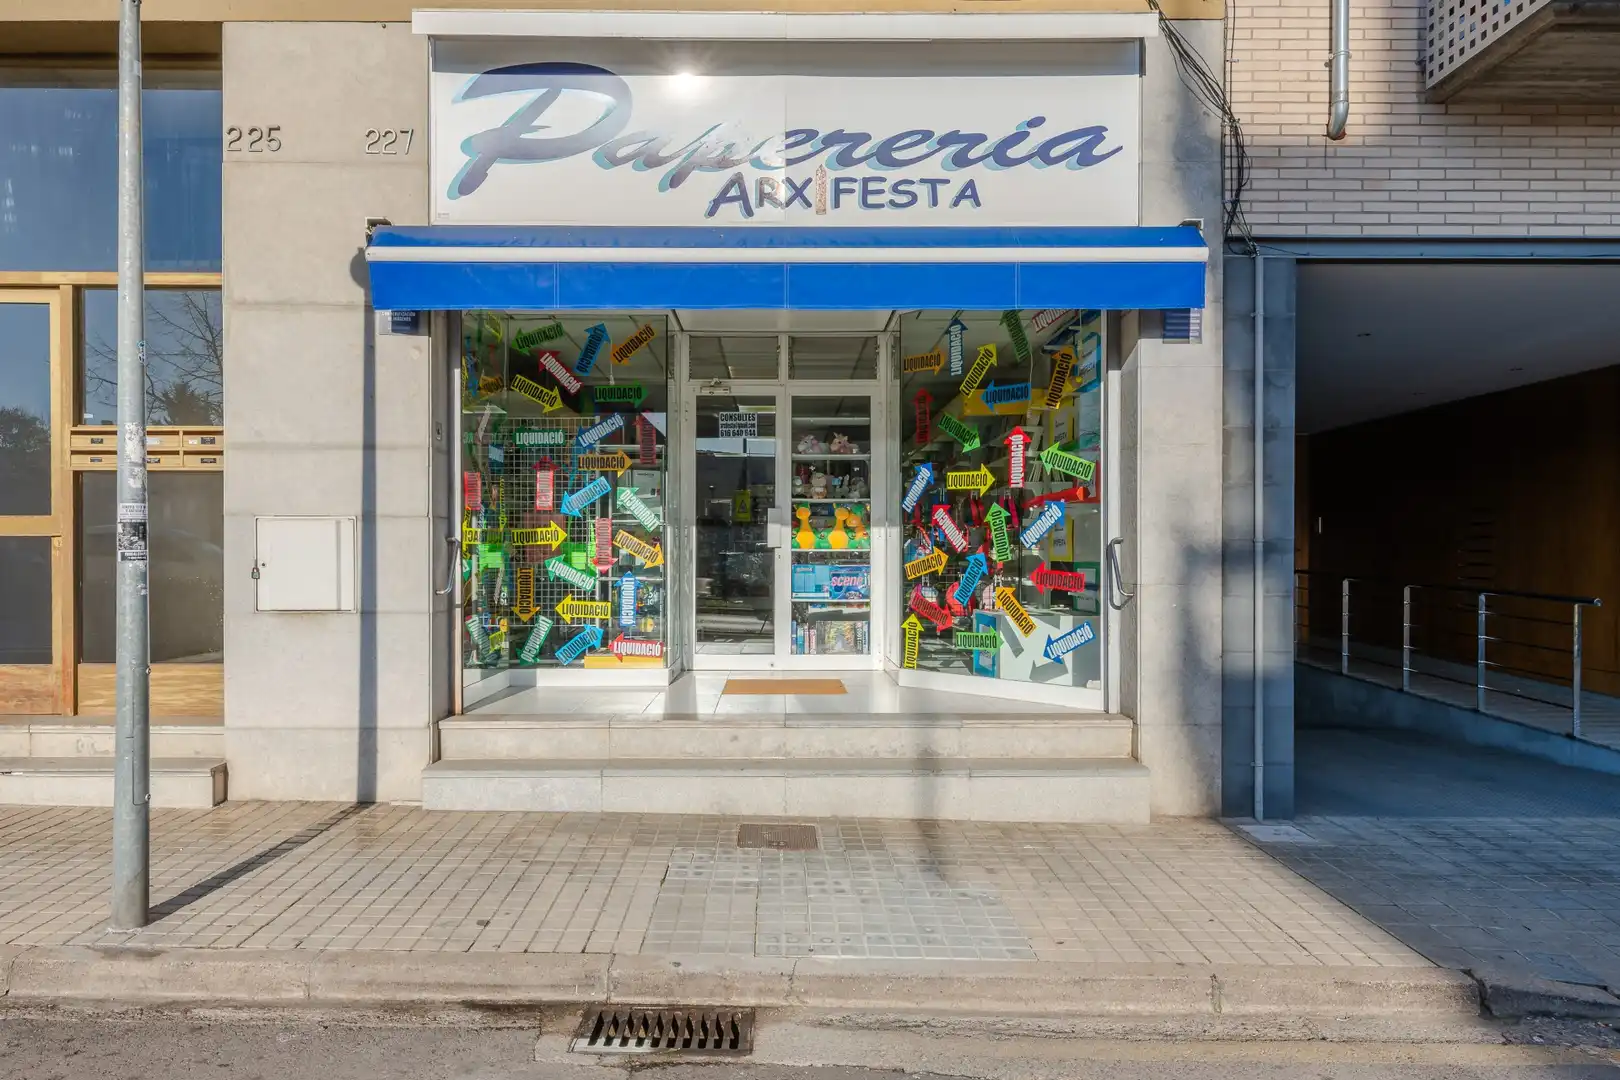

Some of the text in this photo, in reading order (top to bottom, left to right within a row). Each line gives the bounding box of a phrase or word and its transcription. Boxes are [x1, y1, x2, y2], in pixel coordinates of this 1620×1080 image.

[226, 125, 282, 153] 225
[365, 127, 414, 155] 227
[447, 62, 1122, 200] Papereria
[515, 322, 564, 349] LIQUIDACIÓ
[613, 324, 655, 363] LIQUIDACIÓ
[951, 324, 962, 376] LIQUIDACIÓ
[540, 352, 583, 394] LIQUIDACIÓ
[903, 353, 941, 372] LIQUIDACIÓ
[961, 347, 994, 396] LIQUIDACIÓ
[511, 376, 558, 408] LIQUIDACIÓ
[595, 386, 642, 400] LIQUIDACIÓ
[1046, 352, 1073, 409] LIQUIDACIÓ
[578, 413, 624, 447] LIQUIDACIÓ
[720, 413, 756, 422] CONSULTES
[939, 414, 979, 447] LIQUIDACIÓ
[516, 430, 564, 444] LIQUIDACIÓ
[578, 455, 625, 469] LIQUIDACIÓ
[1010, 434, 1025, 487] LIQUIDACIÓ
[1044, 450, 1093, 480] LIQUIDACIÓ
[565, 479, 609, 512] LIQUIDACIÓ
[902, 466, 931, 511] LIQUIDACIÓ
[947, 472, 988, 488] LIQUIDACIÓ
[512, 530, 559, 544] LIQUIDACIÓ
[934, 507, 967, 553] LIQUIDACIÓ
[991, 508, 1010, 562] LIQUIDACIÓ
[1020, 502, 1063, 549] LIQUIDACIÓ
[614, 532, 660, 564] LIQUIDACIÓ
[549, 561, 595, 590] LIQUIDACIÓ
[905, 553, 943, 578] LIQUIDACIÓ
[955, 557, 985, 605] LIQUIDACIÓ
[1035, 571, 1084, 591] LIQUIDACIÓ
[518, 568, 532, 614] LIQUIDACIÓ
[621, 576, 636, 626] LIQUIDACIÓ
[562, 602, 608, 617] LIQUIDACIÓ
[996, 589, 1034, 636] LIQUIDACIÓ
[556, 629, 598, 665] LIQUIDACIÓ
[613, 641, 661, 657] LIQUIDACIÓ
[905, 621, 918, 669] LIQUIDACIÓ
[956, 631, 998, 649] LIQUIDACIÓ
[1047, 622, 1093, 659] LIQUIDACIÓ
